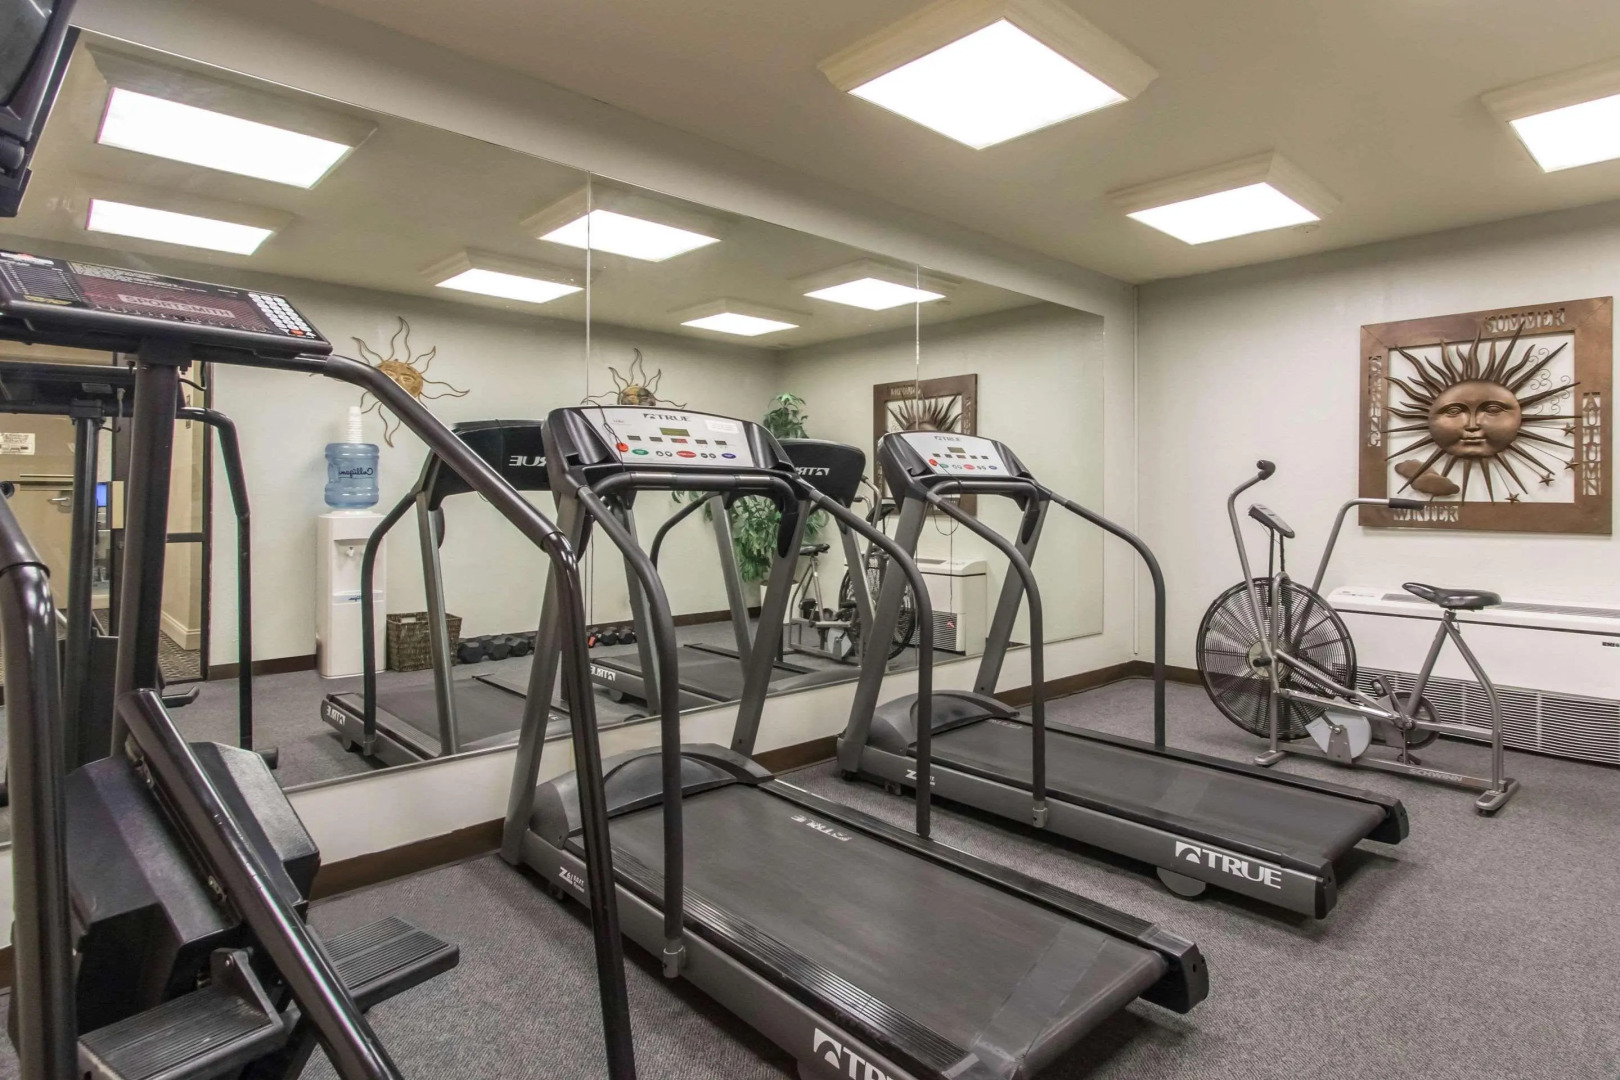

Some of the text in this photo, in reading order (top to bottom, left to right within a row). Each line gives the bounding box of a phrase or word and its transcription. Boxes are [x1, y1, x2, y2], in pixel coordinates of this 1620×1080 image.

[1484, 307, 1565, 333] SUMMER
[1582, 392, 1601, 496] AUTUMN
[1408, 768, 1463, 782] SCHWINN
[1202, 848, 1282, 889] TRUE
